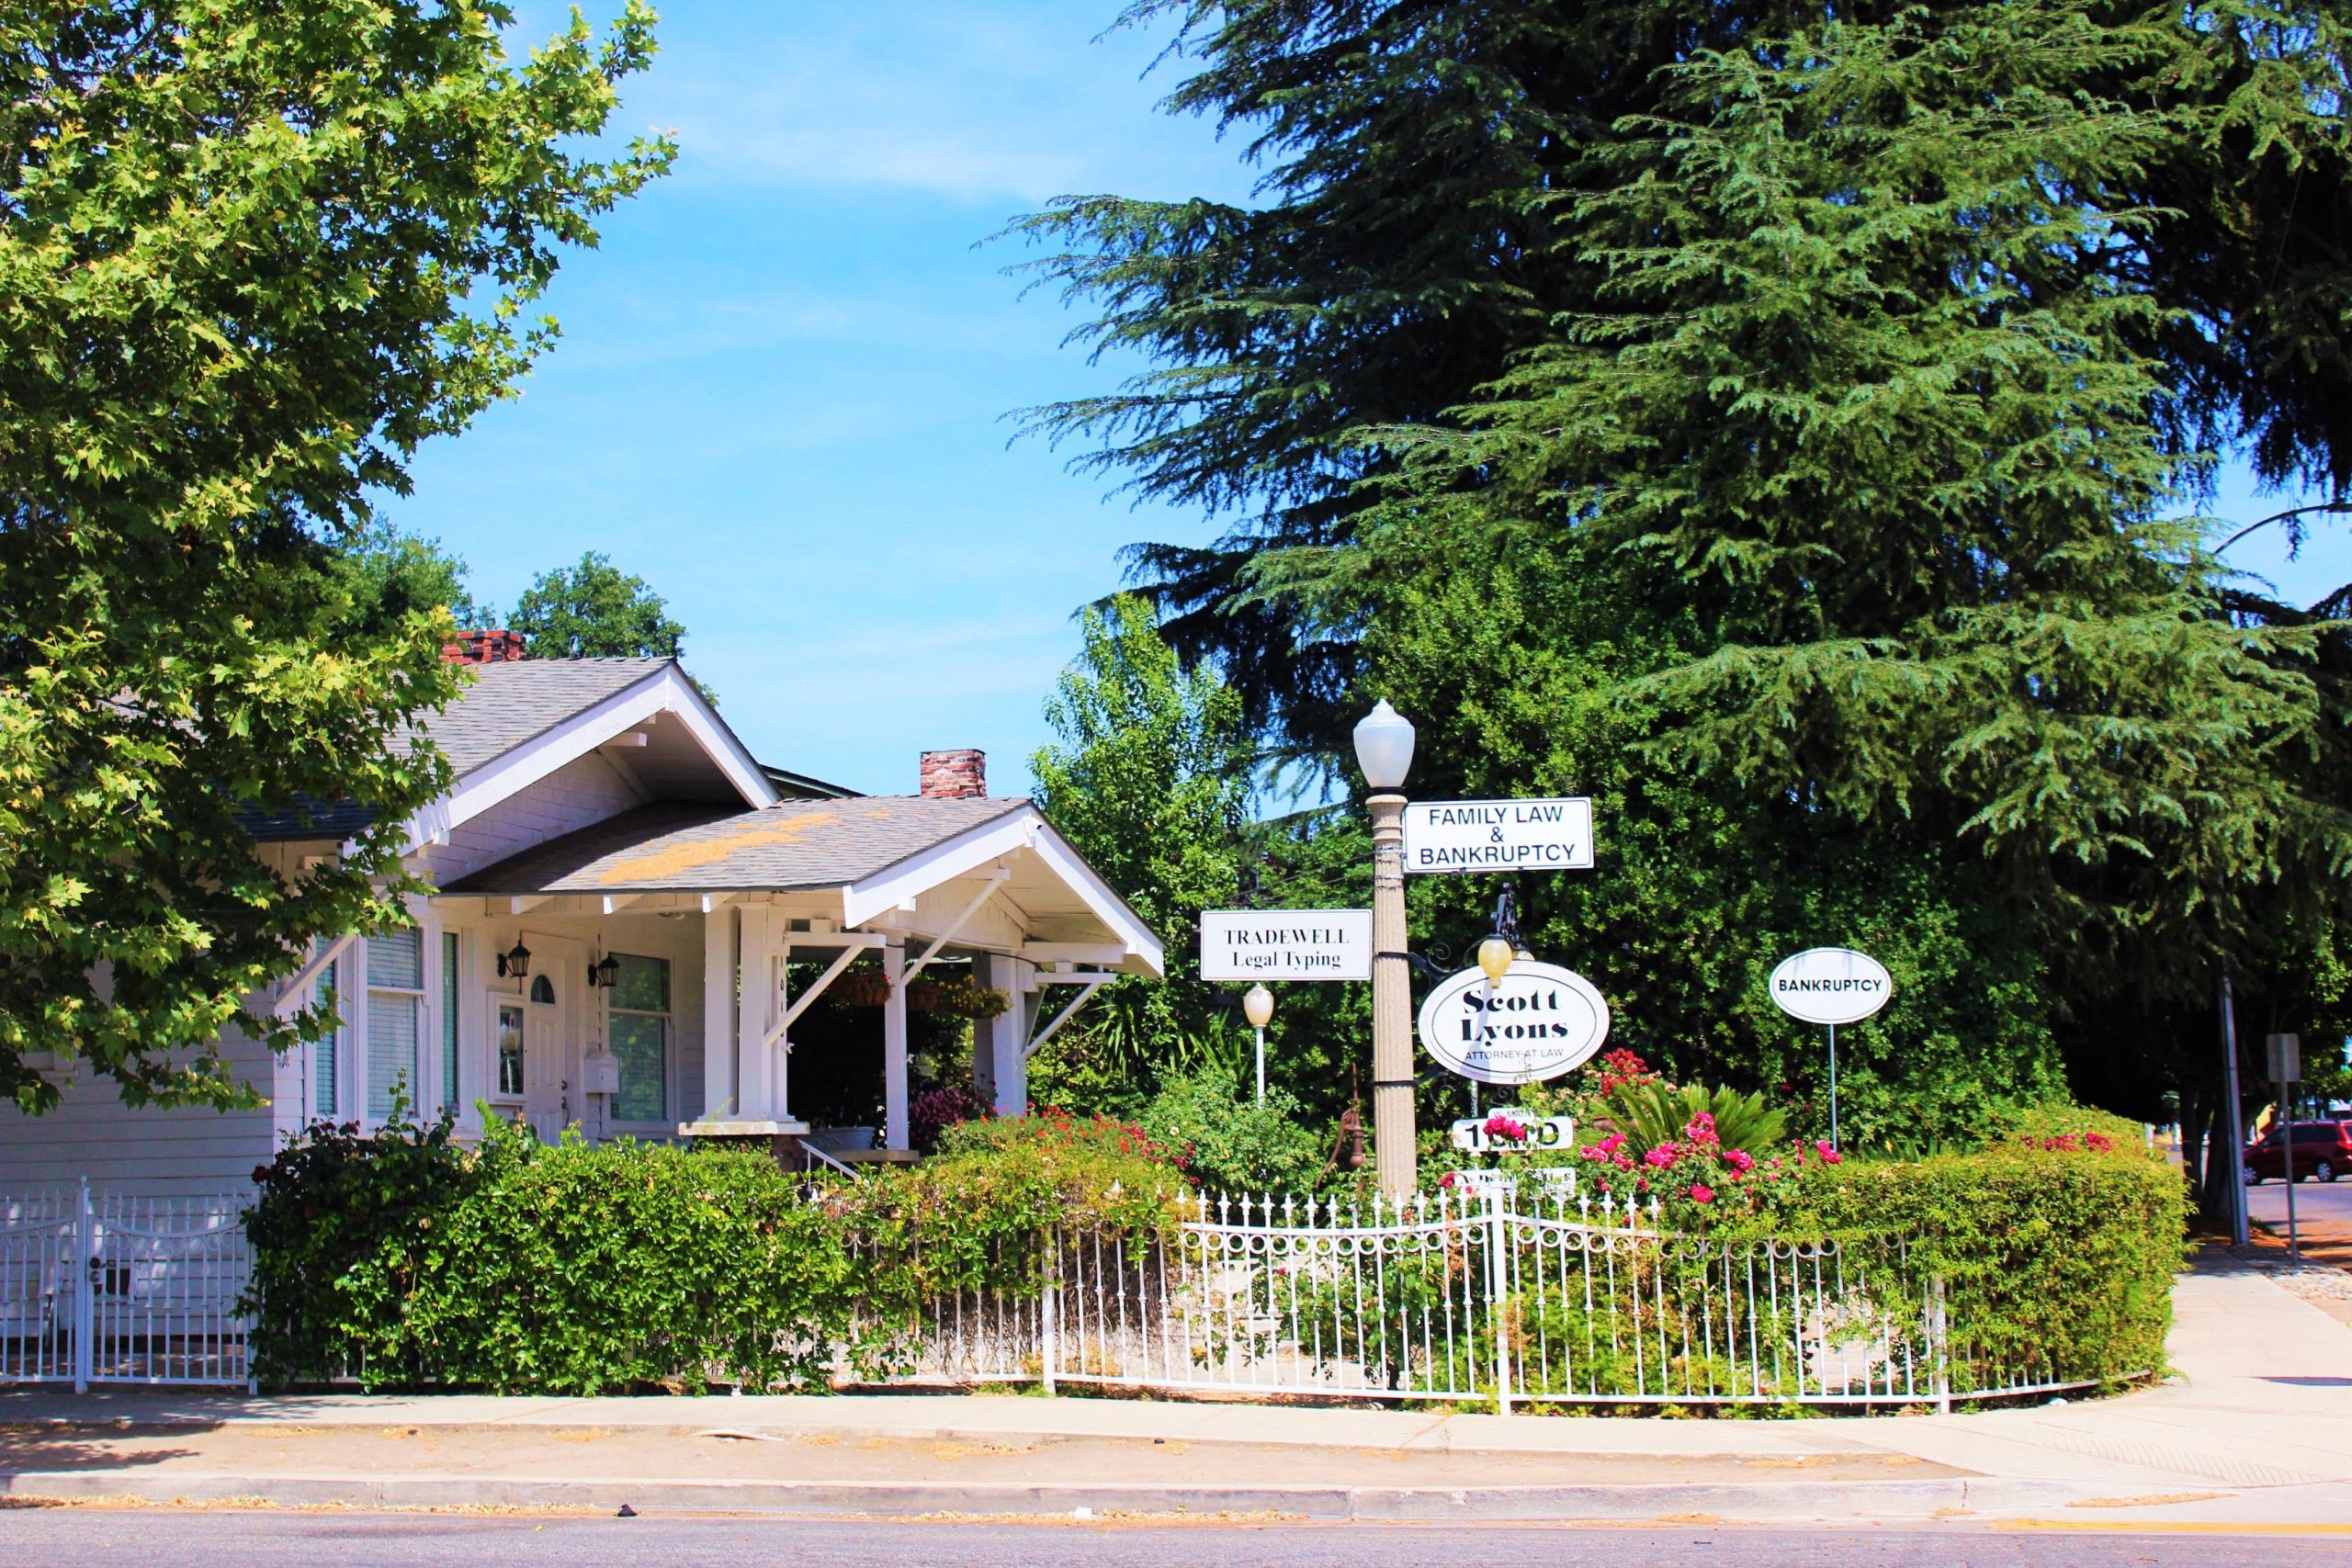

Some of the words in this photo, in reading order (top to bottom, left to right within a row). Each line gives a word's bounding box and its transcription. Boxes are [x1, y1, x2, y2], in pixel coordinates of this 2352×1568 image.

[1430, 807, 1506, 826] FAMILY
[1516, 806, 1564, 823] LAW
[1490, 827, 1505, 843] &
[1420, 844, 1576, 864] BANKRUPTCY
[1224, 929, 1350, 945] TRADEWELL
[1233, 952, 1278, 970] Legal
[1284, 952, 1341, 970] Typing
[1779, 979, 1882, 991] BANKRUPTCY
[1463, 988, 1561, 1014] Scott
[1461, 1019, 1568, 1046] Lyons
[1465, 1050, 1524, 1060] ATTORNEY
[1525, 1049, 1537, 1057] AT
[1541, 1048, 1563, 1057] LAW
